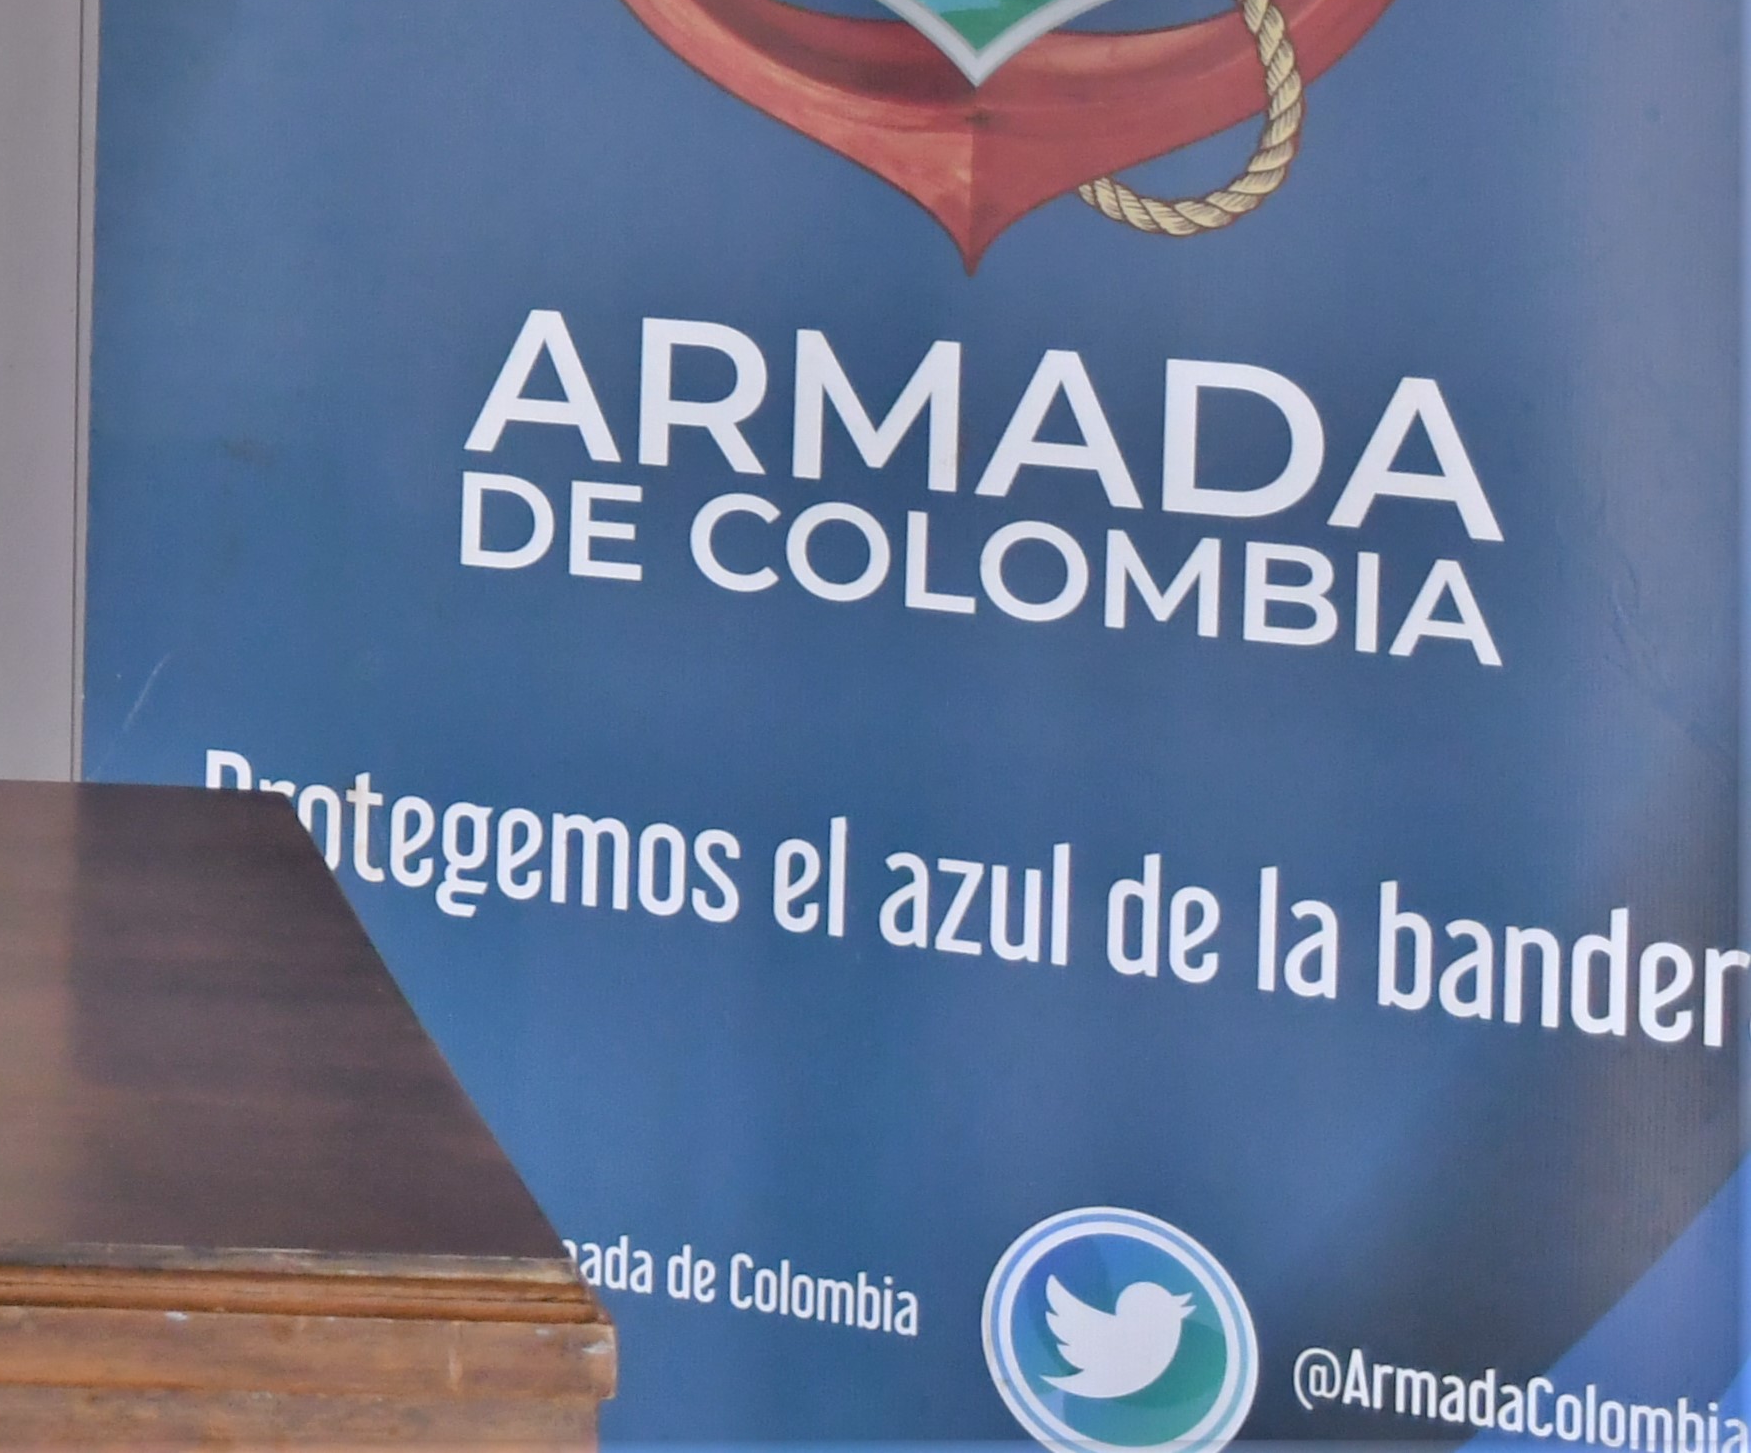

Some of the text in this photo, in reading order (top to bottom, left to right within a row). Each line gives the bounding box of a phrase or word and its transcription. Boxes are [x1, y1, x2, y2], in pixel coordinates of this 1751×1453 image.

[463, 308, 1504, 542] ARMADA
[459, 471, 1504, 667] DE COLOMBIA
[205, 748, 1751, 1049] otegemos el azul de la bander
[562, 1234, 919, 1336] ada de Colombia
[1293, 1347, 1750, 1453] @ArmadaColombia
